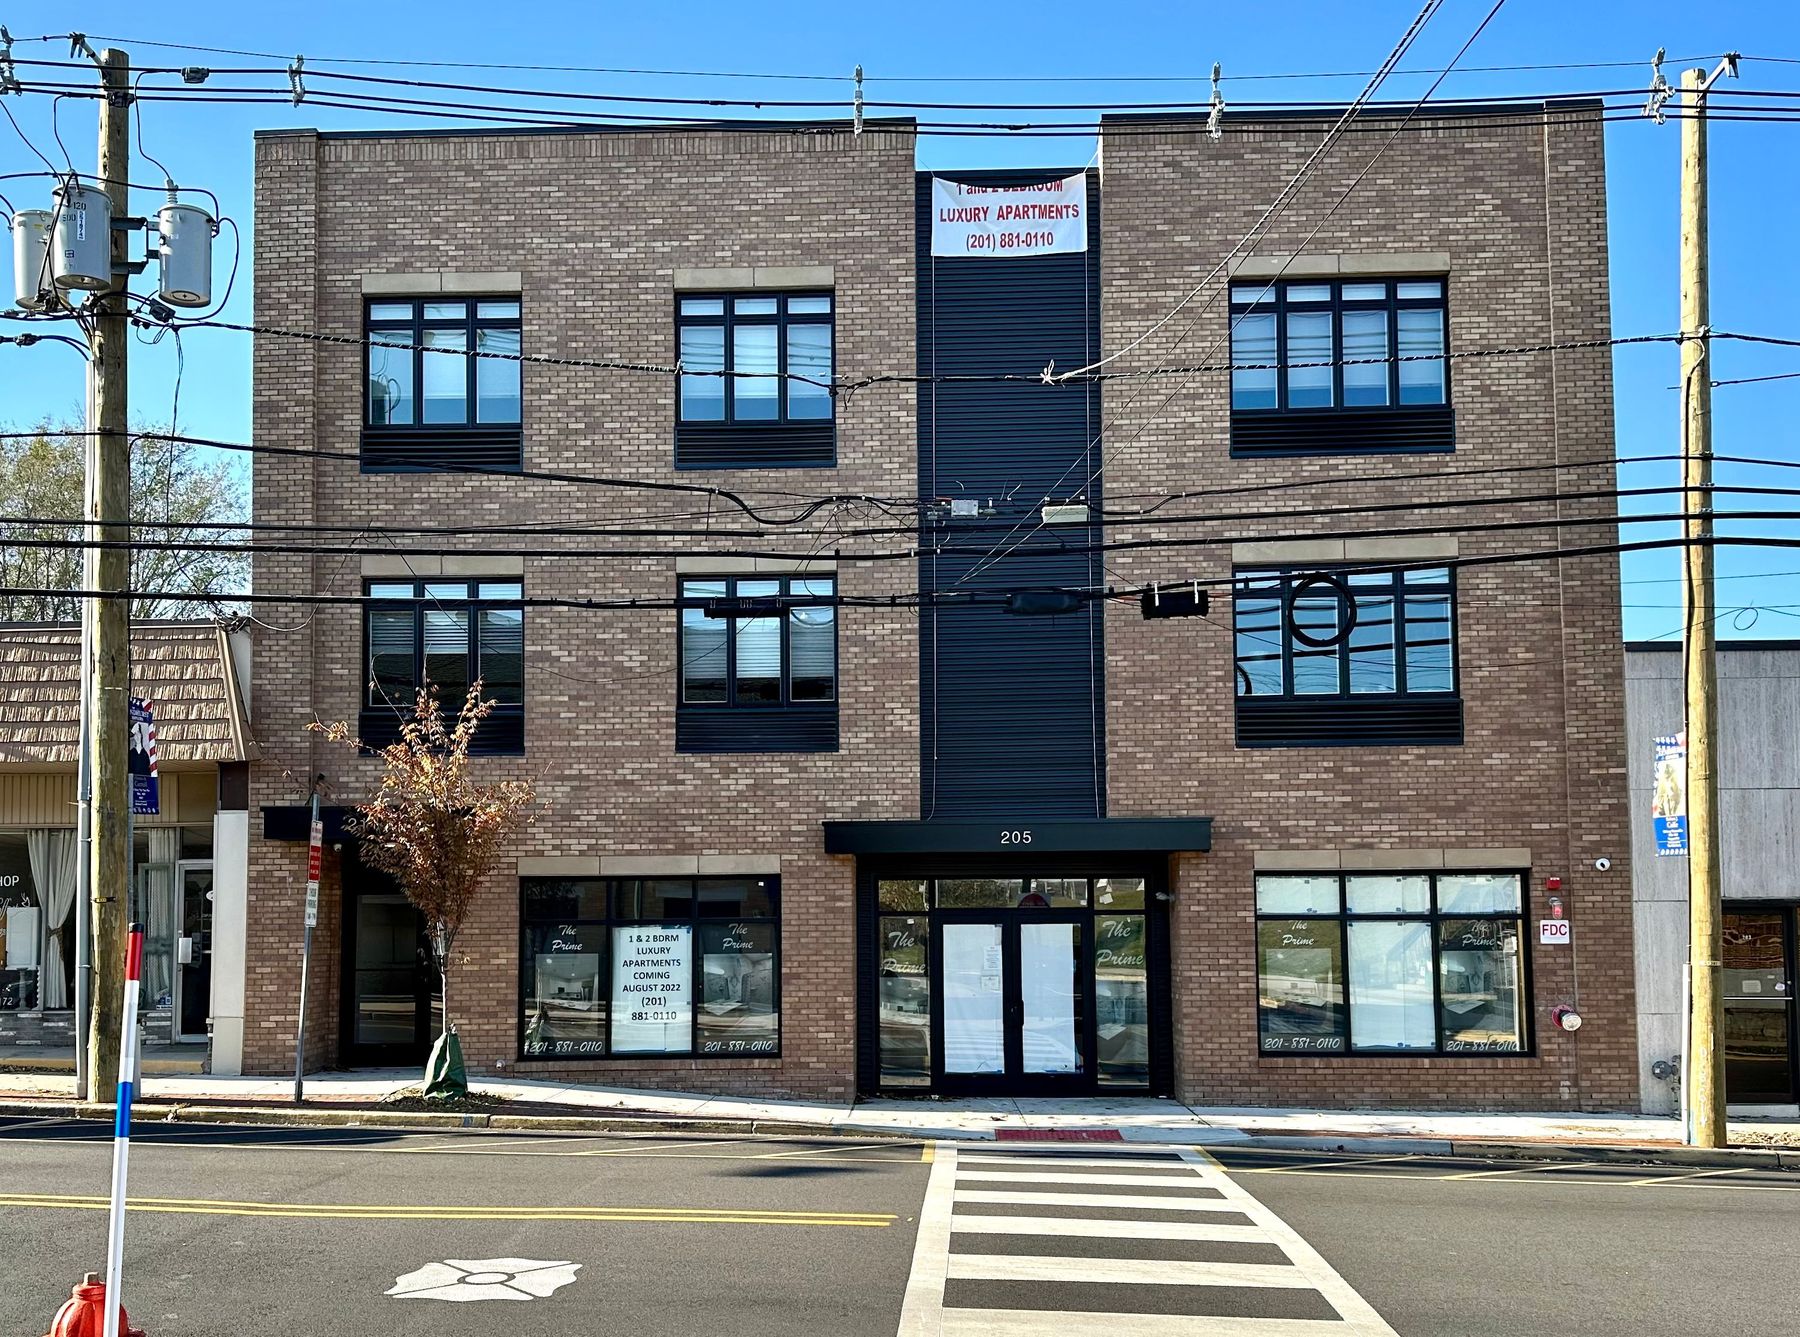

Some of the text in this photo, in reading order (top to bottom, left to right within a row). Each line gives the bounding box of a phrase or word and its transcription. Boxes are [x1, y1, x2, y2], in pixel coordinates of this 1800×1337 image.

[940, 204, 1080, 222] LUXURY APARTMENTS
[966, 232, 1054, 251] (201) 881-0110
[1001, 831, 1032, 844] 205
[559, 925, 577, 935] The
[728, 923, 747, 935] The
[1102, 921, 1131, 938] The
[1288, 920, 1308, 930] The
[1542, 924, 1567, 936] FDC
[552, 940, 582, 951] Prime
[723, 938, 753, 950] Prime
[888, 932, 914, 948] The
[1282, 934, 1315, 946] Prime
[1462, 934, 1496, 946] Prime
[622, 959, 681, 967] APARTMENTS
[1096, 950, 1143, 966] Prime
[880, 958, 925, 974] Prime
[633, 972, 670, 980] COMING
[642, 997, 666, 1007] (201)
[632, 1011, 676, 1021] 881-0110
[705, 1041, 773, 1052] 201-881-0110
[1265, 1038, 1340, 1049] 201-881-0110
